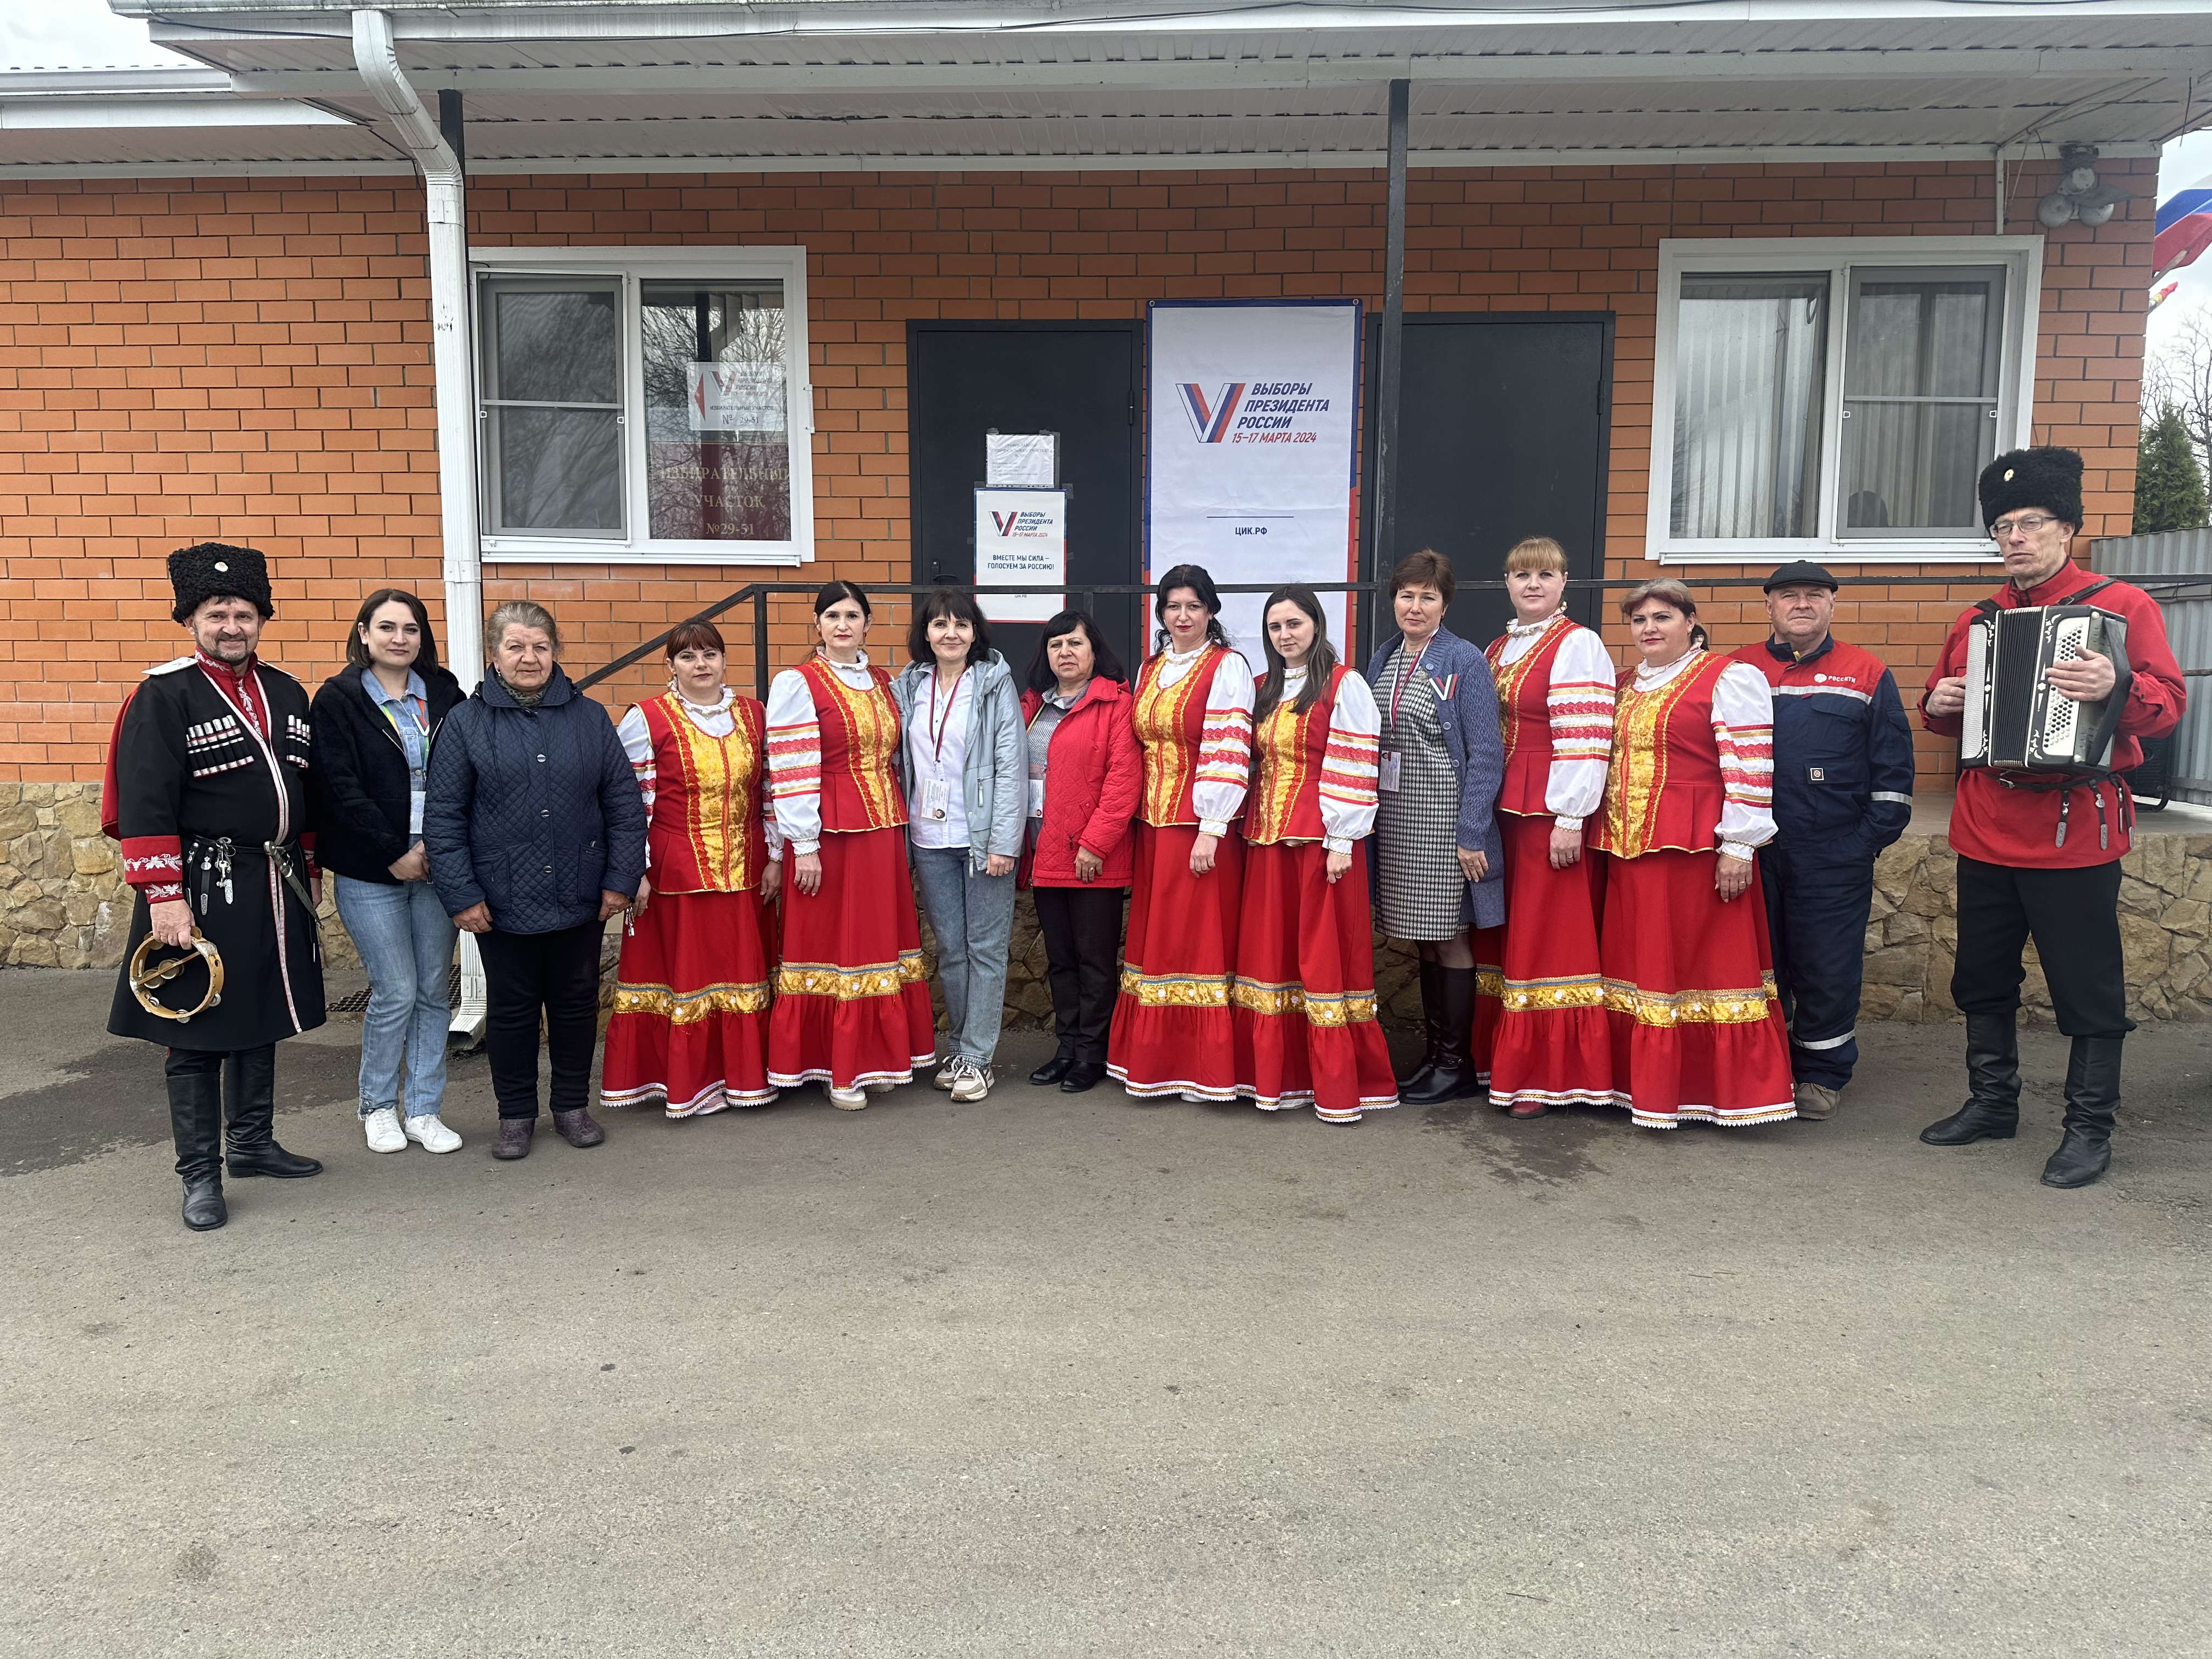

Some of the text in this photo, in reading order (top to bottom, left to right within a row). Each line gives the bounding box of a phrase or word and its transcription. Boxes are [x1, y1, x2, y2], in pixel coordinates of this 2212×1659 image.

[1251, 382, 1313, 395] ВЫБОРЫ
[1244, 399, 1330, 413] ПРЕЗИДЕНТА
[1237, 416, 1293, 428] РОССИИ
[1259, 432, 1291, 443] МАРТА
[1293, 432, 1317, 443] 2024
[695, 495, 766, 508] УЧАСТОК
[1235, 527, 1267, 536] ЦИК.РФ
[1828, 675, 1856, 684] РОССЕТИ
